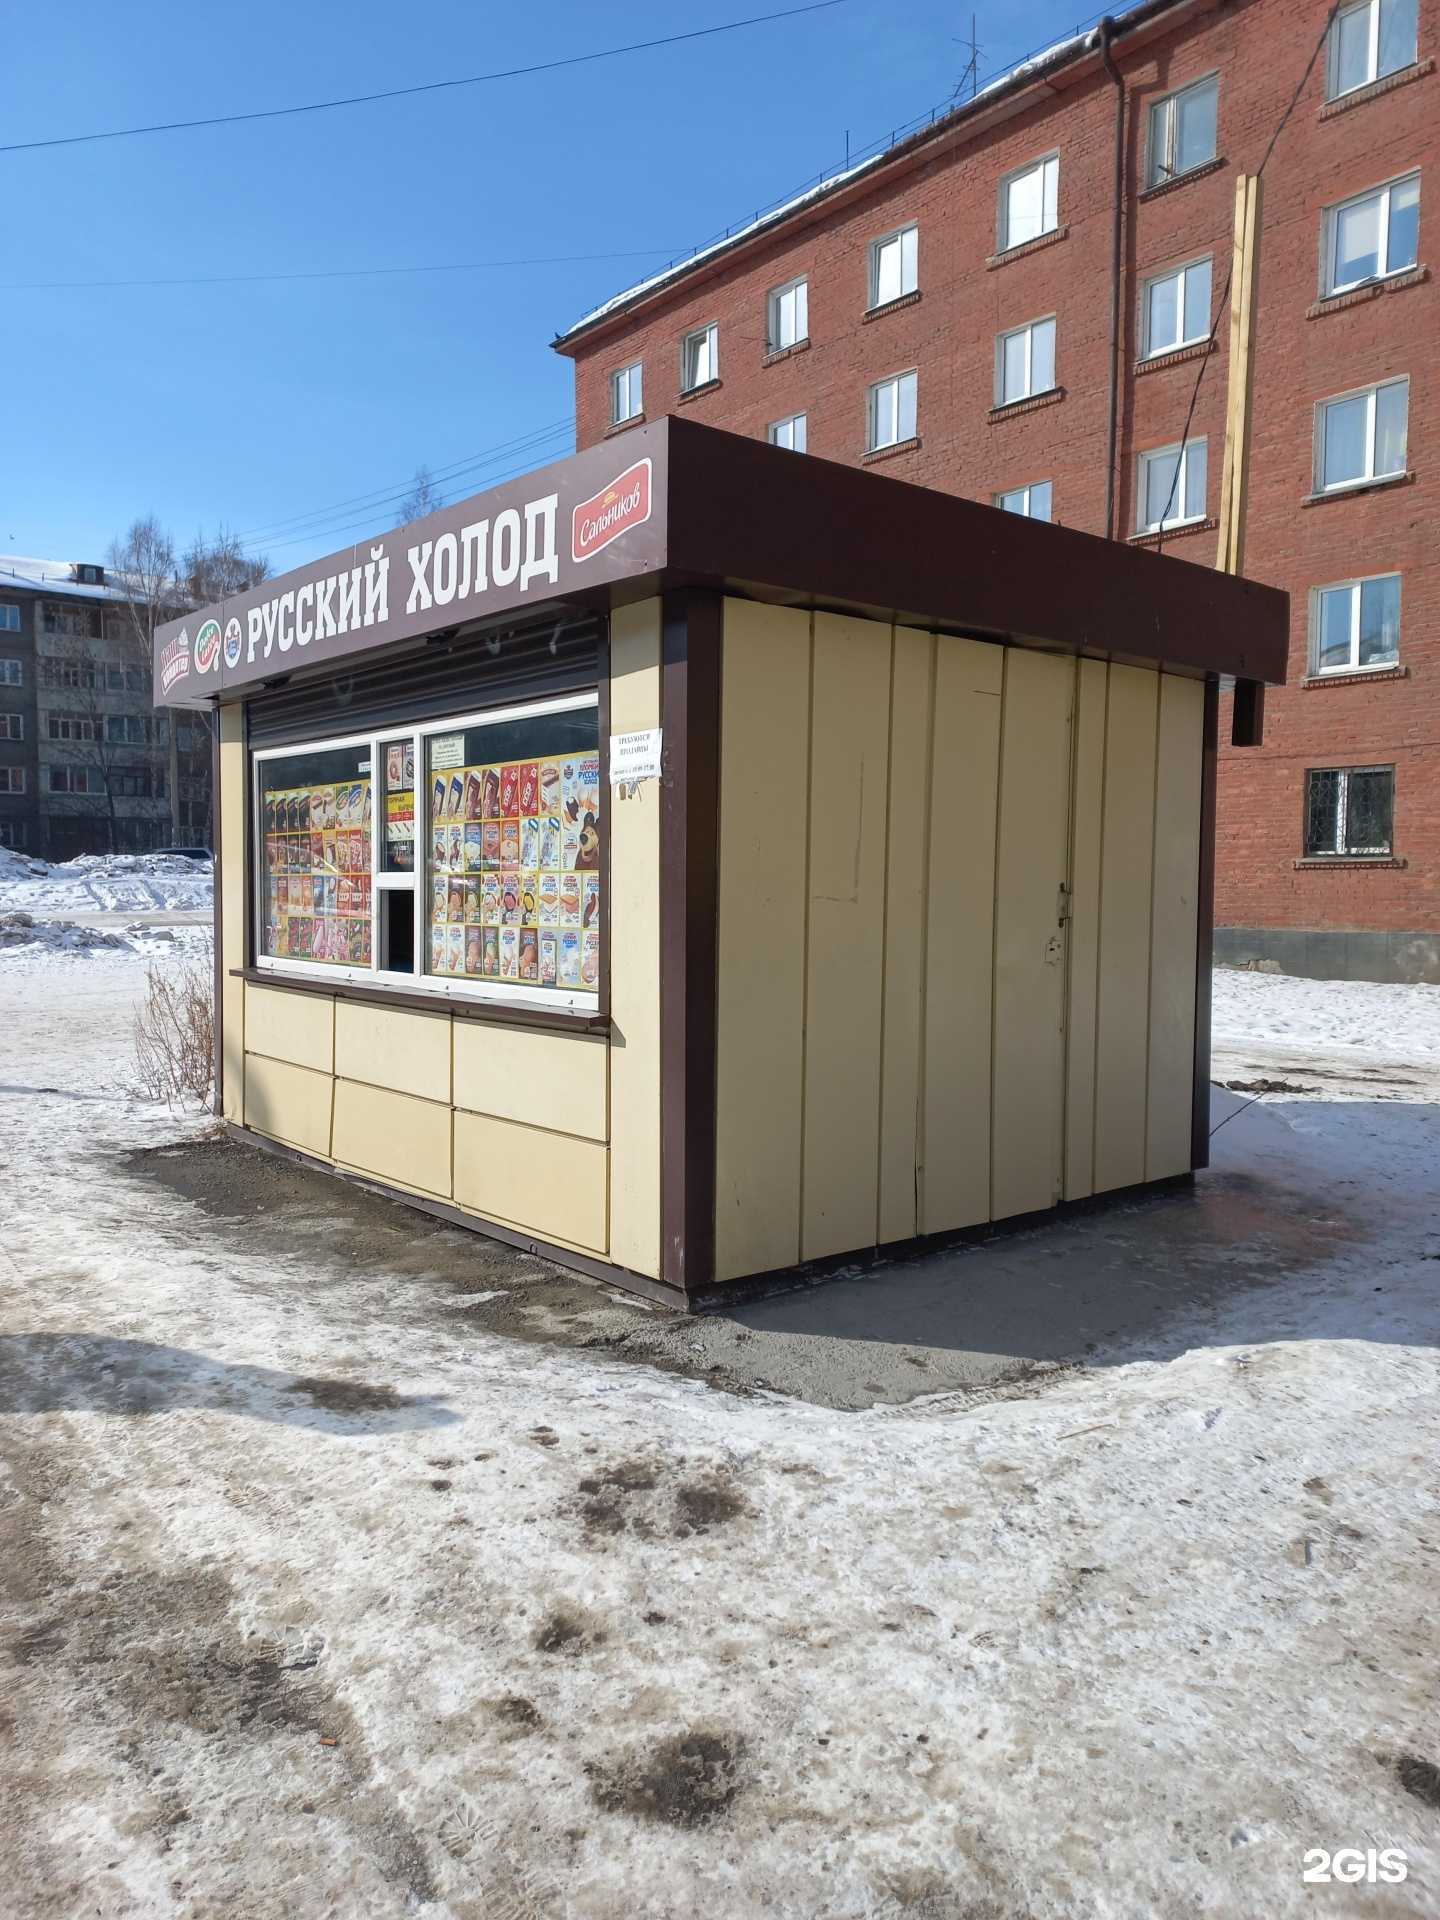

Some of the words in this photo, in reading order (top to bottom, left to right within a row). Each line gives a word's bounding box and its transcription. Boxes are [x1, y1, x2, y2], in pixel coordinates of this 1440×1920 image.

[580, 481, 640, 547] Сальников
[247, 543, 390, 664] РУССКИЙ
[406, 493, 559, 615] ХОЛОД
